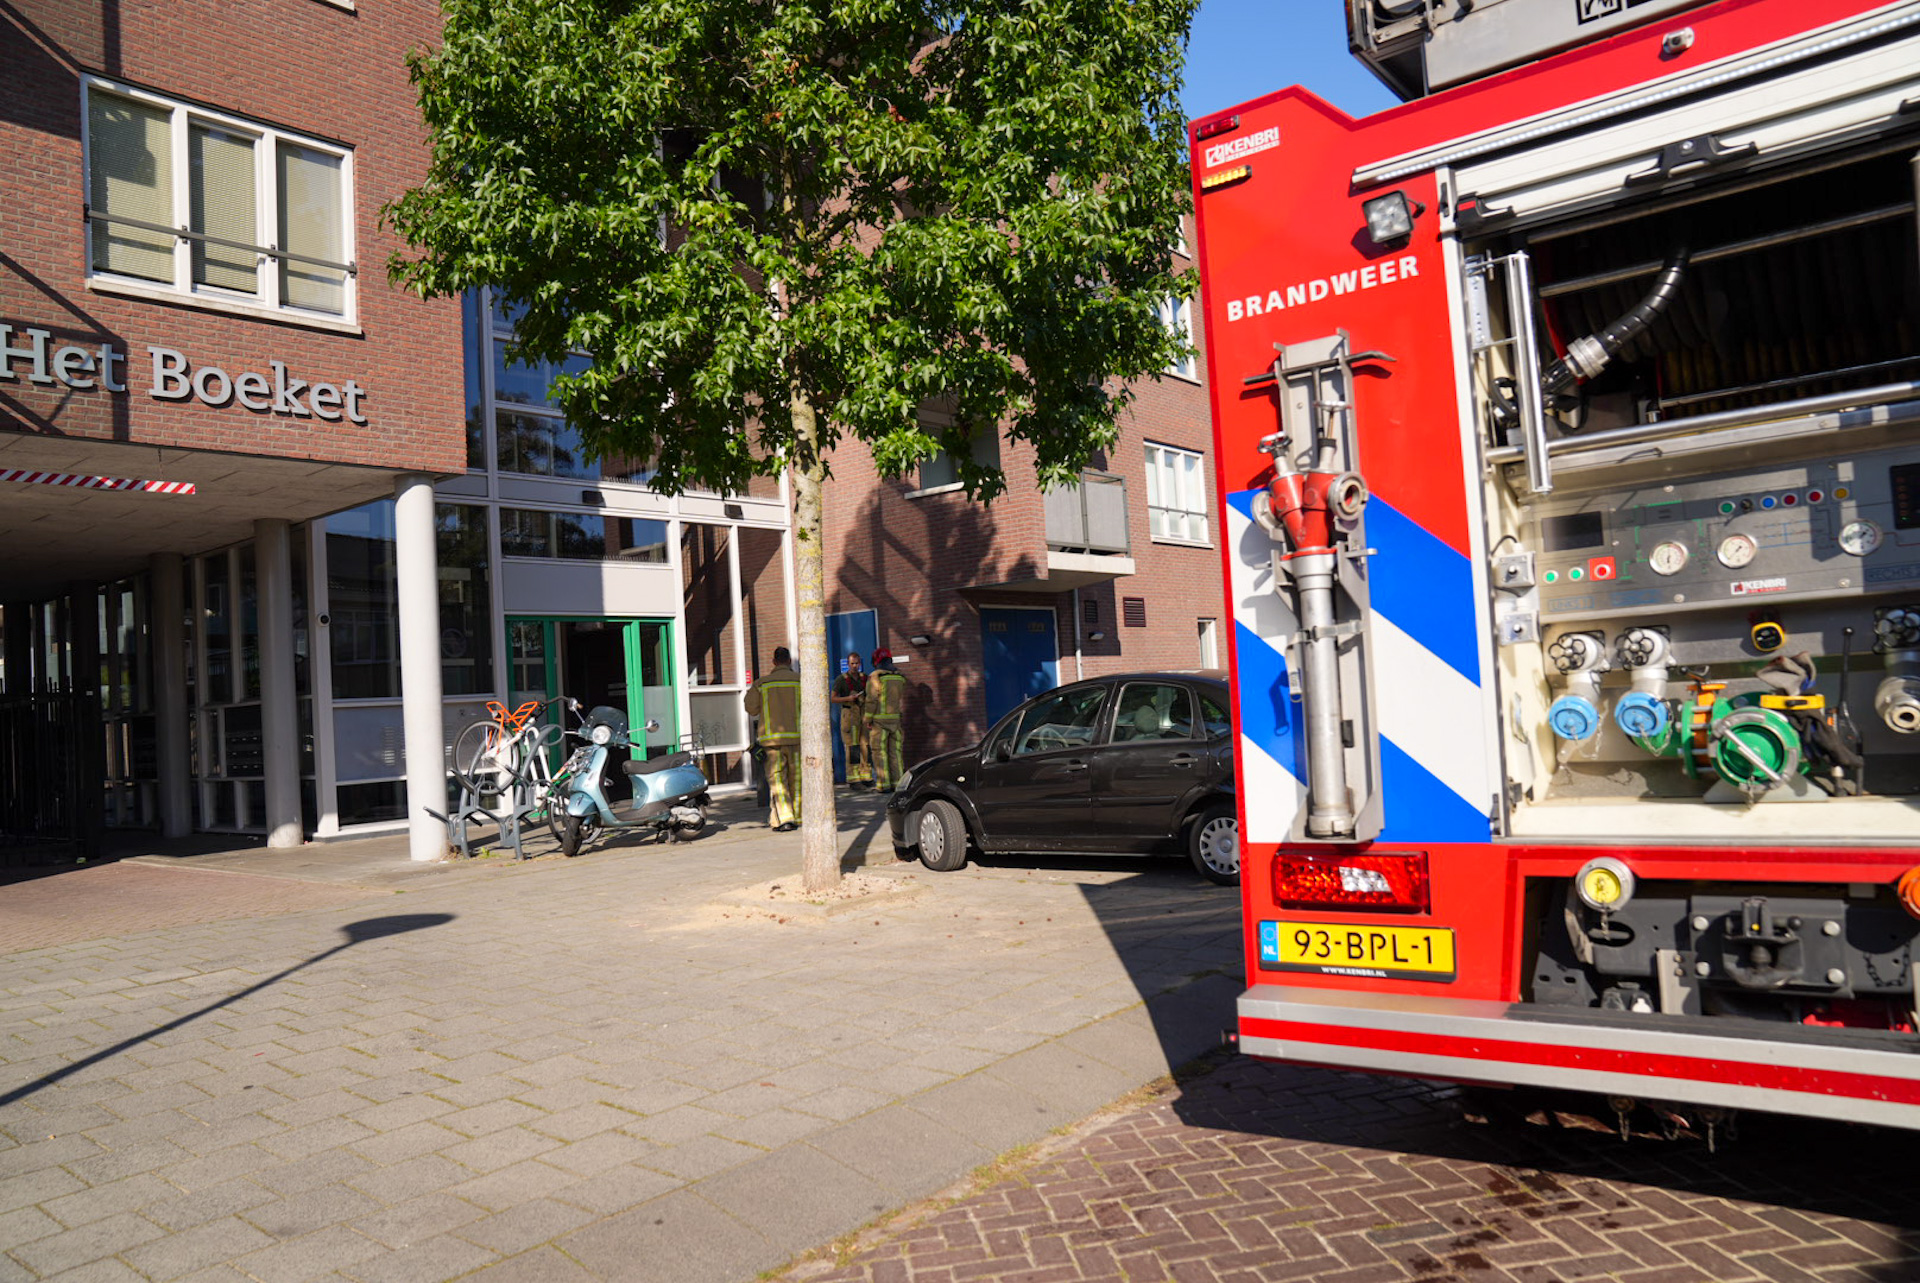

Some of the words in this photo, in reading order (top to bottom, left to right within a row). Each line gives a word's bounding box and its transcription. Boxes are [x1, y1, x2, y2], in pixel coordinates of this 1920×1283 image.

[1225, 126, 1280, 155] KENBRI
[1226, 255, 1420, 323] BRANDWEER
[0, 323, 126, 393] Het
[147, 346, 366, 422] Boeket
[1263, 945, 1276, 955] NL
[1294, 929, 1433, 964] 93-BPL-1
[1321, 966, 1388, 978] WWW.KENBRI.NL
